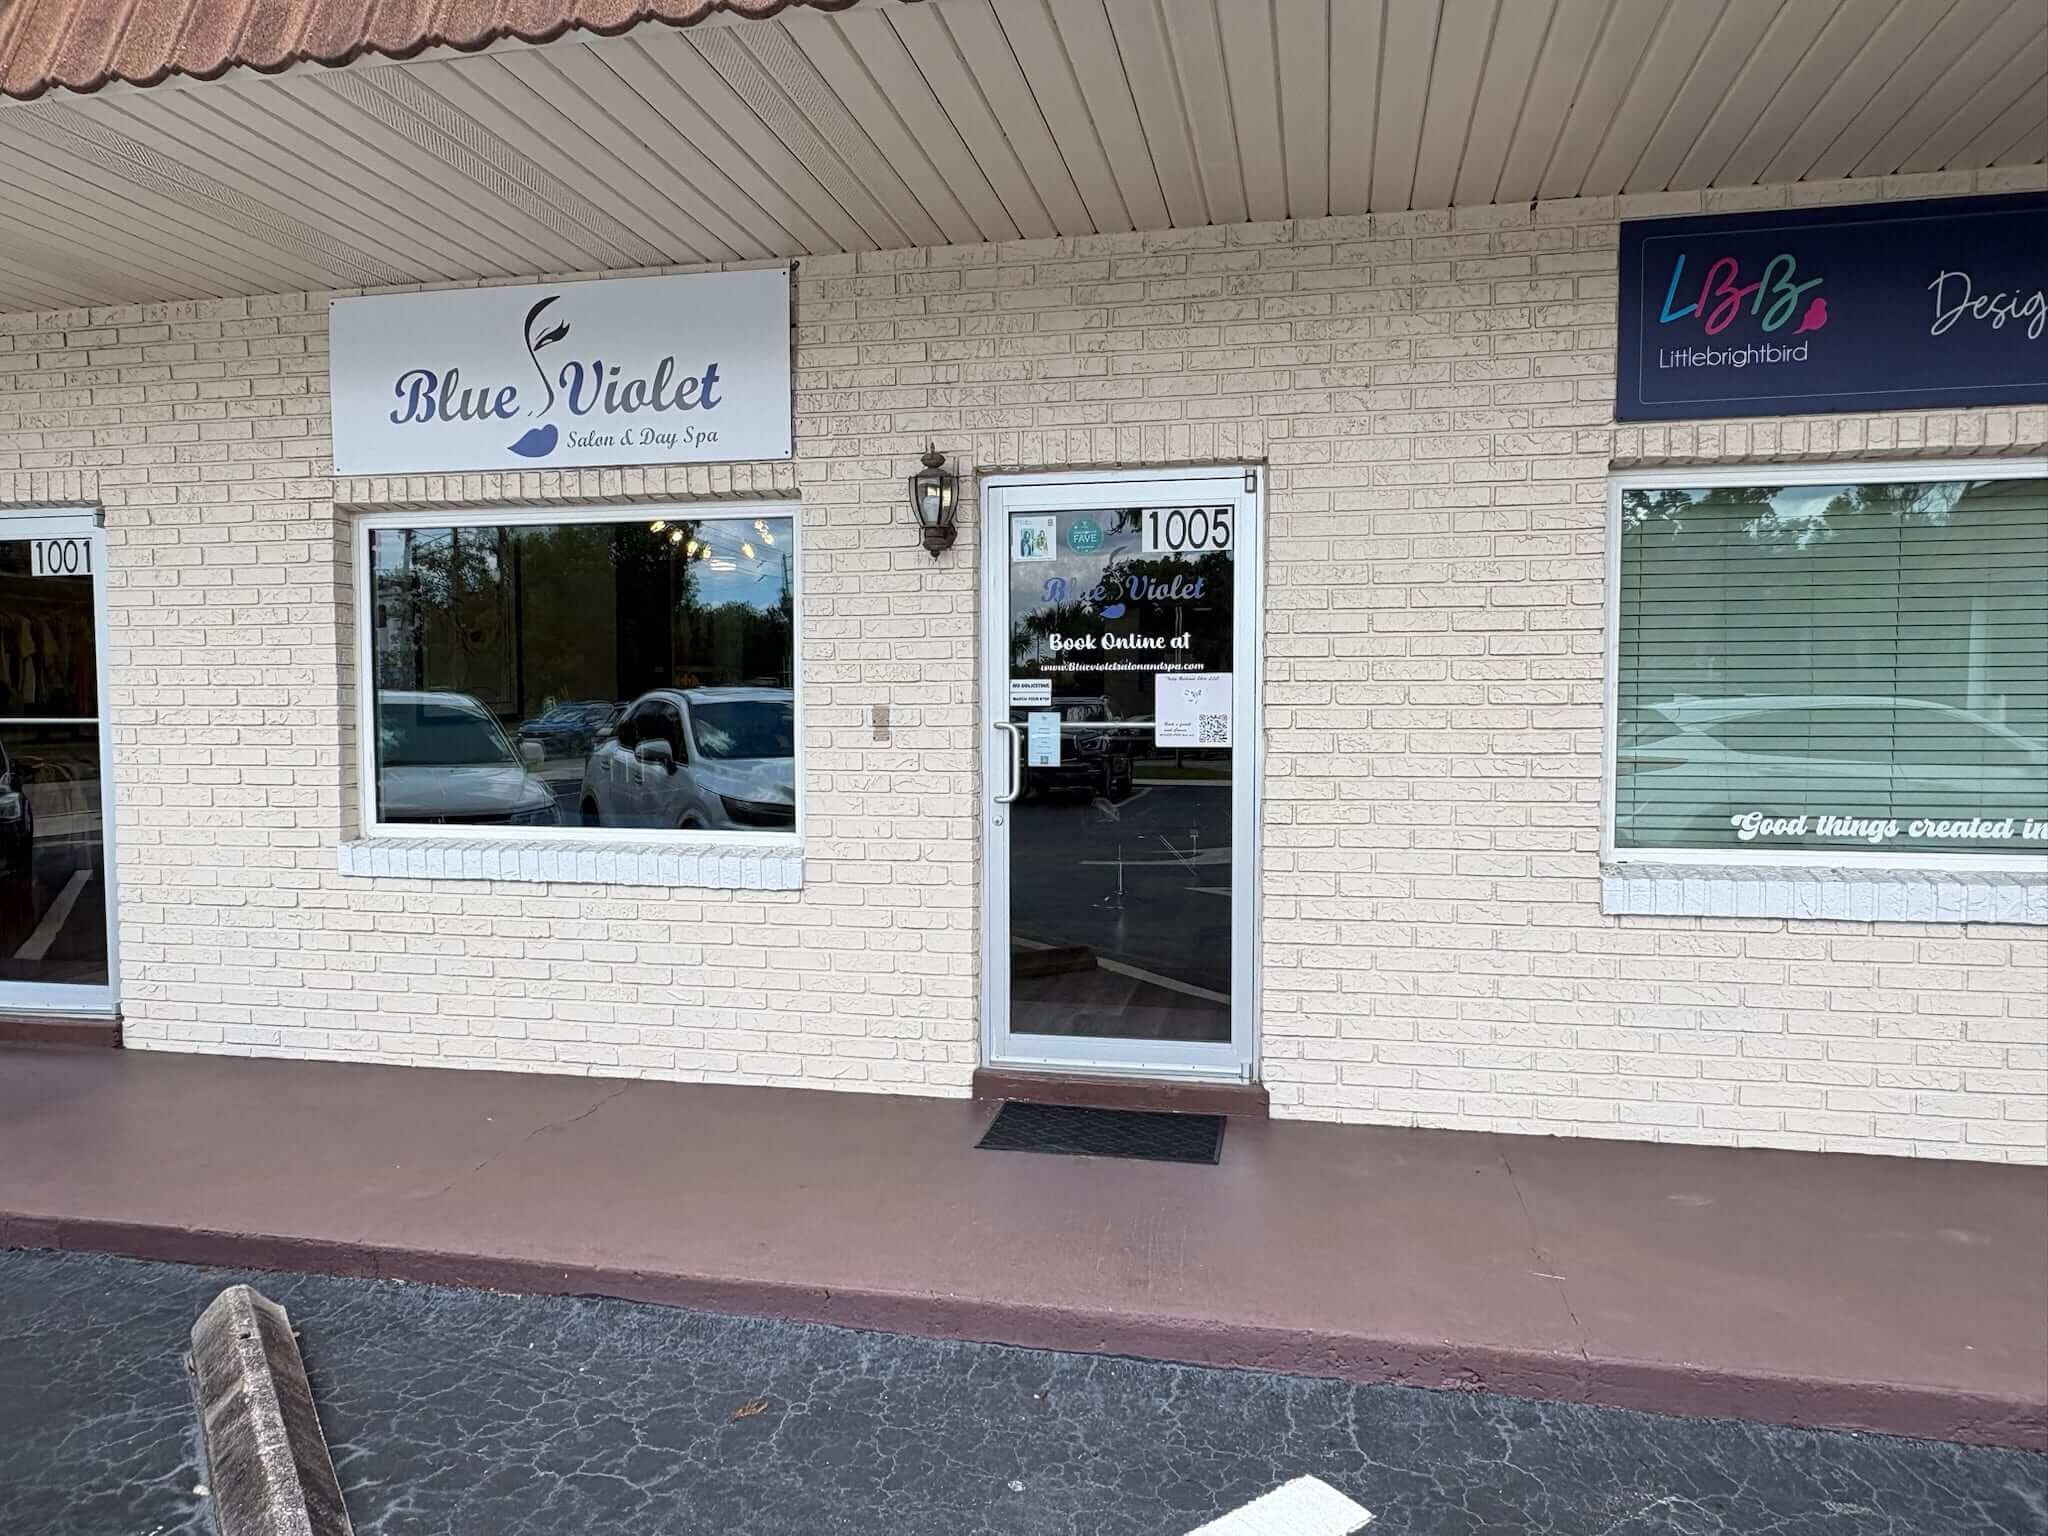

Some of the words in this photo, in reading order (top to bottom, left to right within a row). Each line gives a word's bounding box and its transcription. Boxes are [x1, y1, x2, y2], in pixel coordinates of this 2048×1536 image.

[1659, 341, 1809, 369] Littlebrightbird
[390, 367, 521, 424] Blue
[558, 355, 723, 416] Violet
[566, 429, 615, 448] Salon
[620, 429, 634, 446] &
[639, 427, 679, 449] Day
[683, 425, 720, 448] Spa
[1073, 533, 1097, 544] FAVE
[1148, 509, 1231, 550] 1005
[35, 540, 91, 574] 1001
[1125, 574, 1207, 601] Violet
[1049, 633, 1097, 650] Book
[1101, 632, 1166, 650] Online
[1170, 631, 1192, 650] at
[1730, 811, 1809, 841] Good
[1816, 815, 1899, 844] things
[1908, 818, 2015, 840] created
